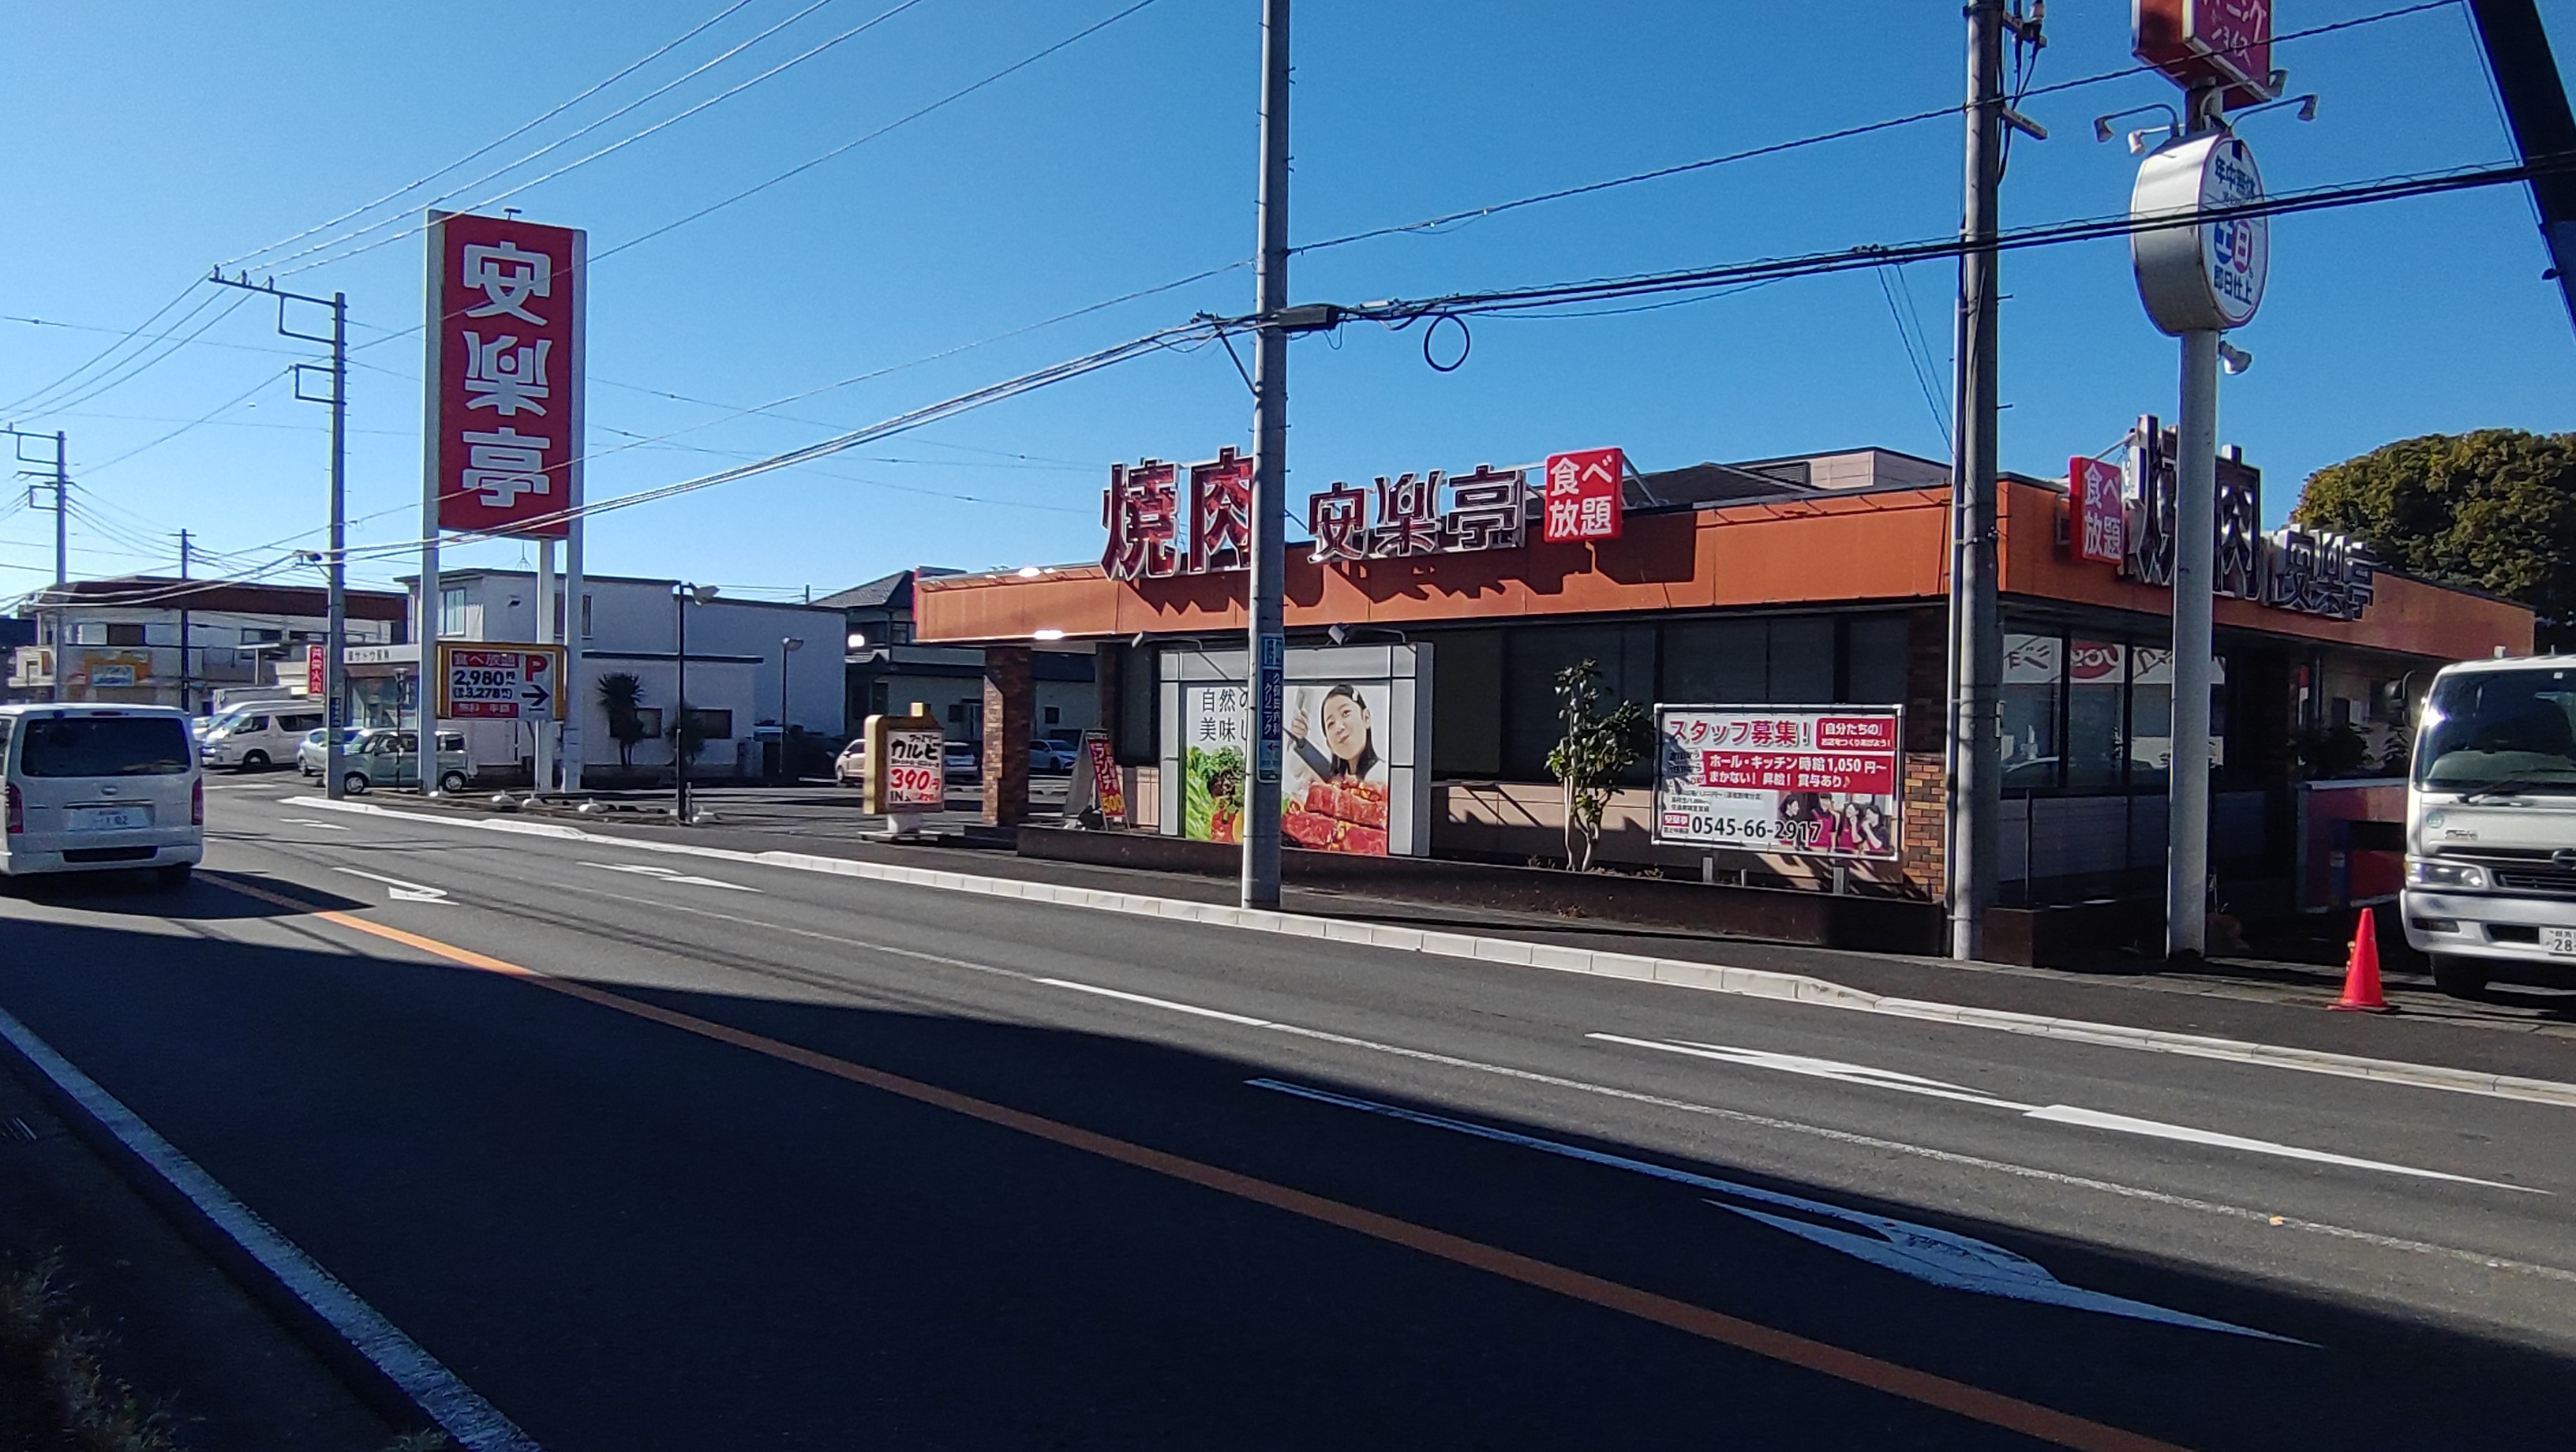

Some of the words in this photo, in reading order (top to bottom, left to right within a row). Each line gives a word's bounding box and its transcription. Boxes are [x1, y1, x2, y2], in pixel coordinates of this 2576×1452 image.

[2215, 264, 2252, 305] 即日仕上
[462, 240, 552, 507] 安楽亭
[1549, 455, 1612, 499] 食べ
[2084, 462, 2121, 510] 食べ
[1100, 445, 1252, 582] 焼肉
[1307, 463, 1523, 563] 安楽亭
[1548, 496, 1612, 538] 放題
[2084, 511, 2121, 559] 放題
[525, 655, 548, 682] P
[1264, 682, 1272, 735] クリニック
[891, 739, 942, 760] カルビ
[1692, 816, 1822, 842] 0545-66-2917
